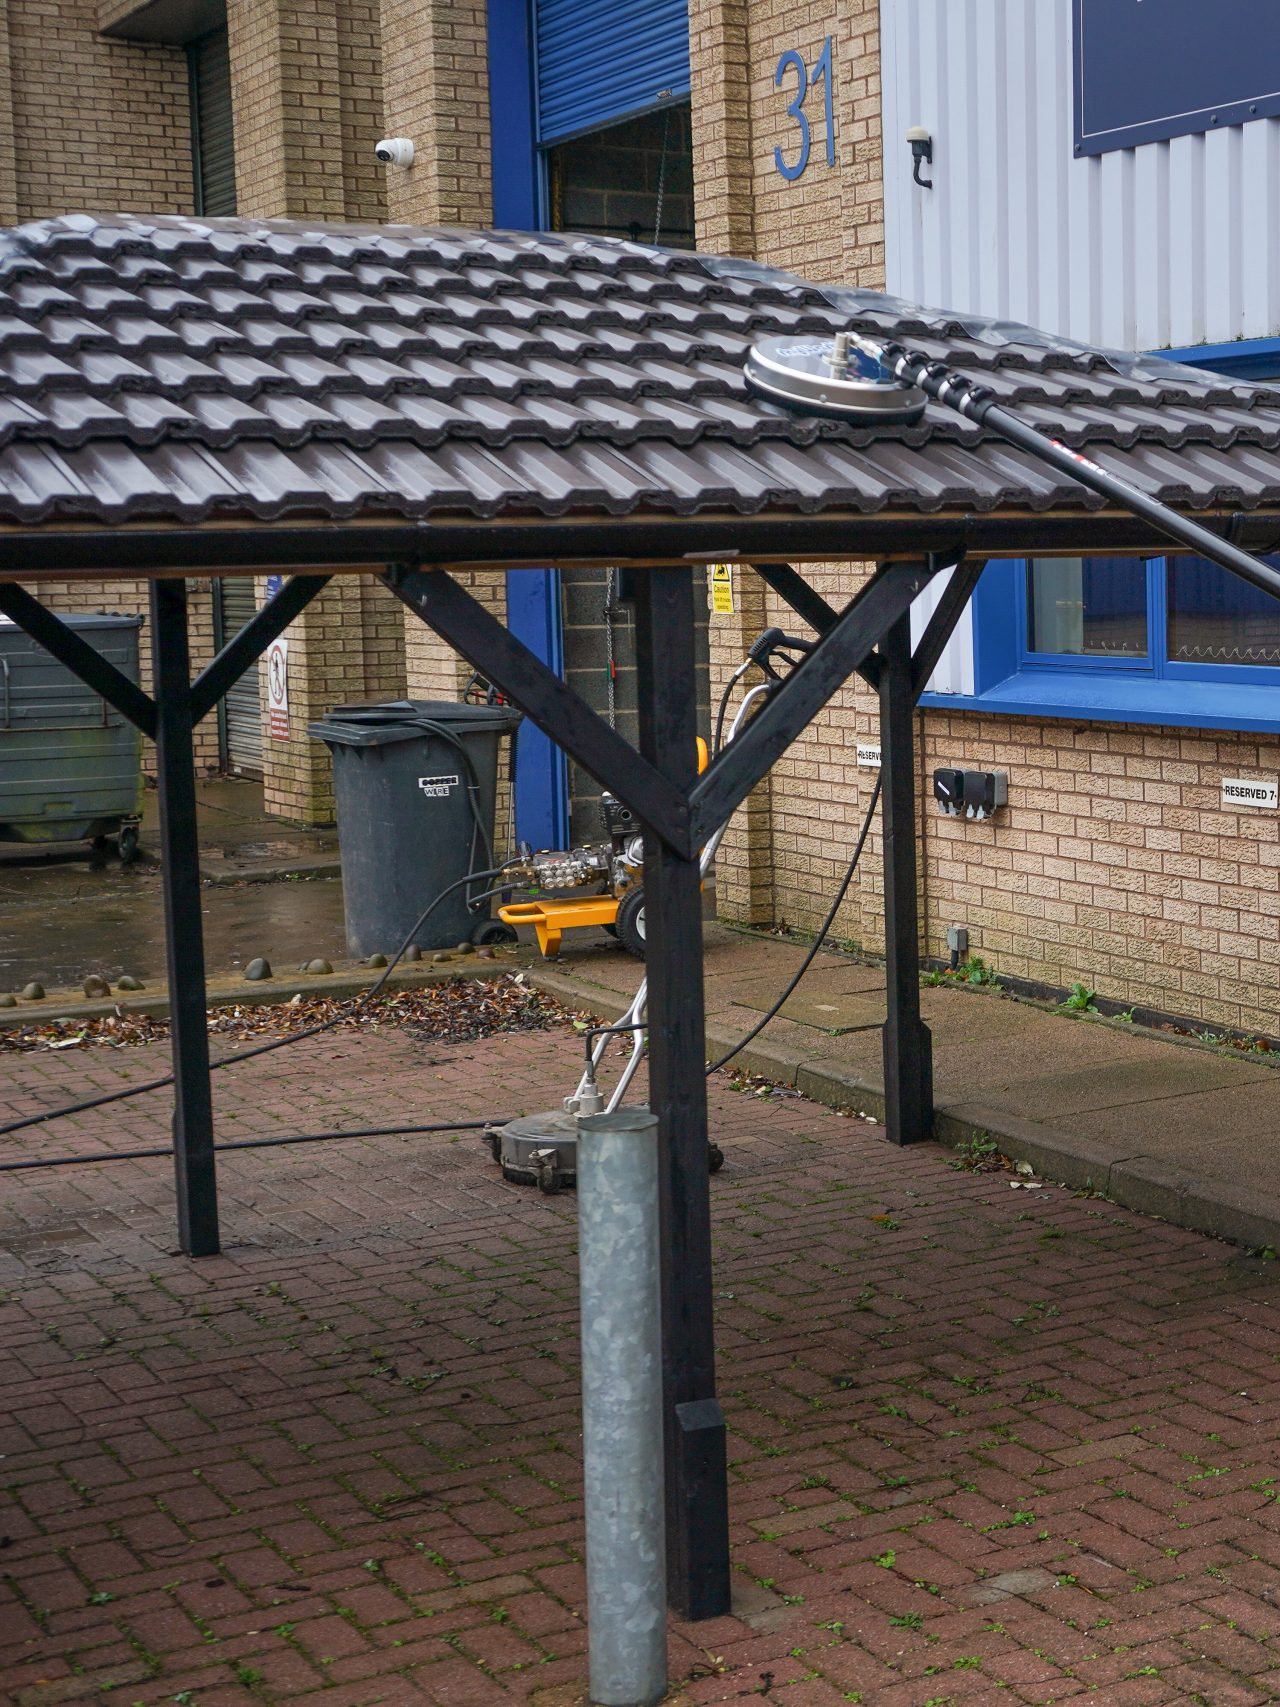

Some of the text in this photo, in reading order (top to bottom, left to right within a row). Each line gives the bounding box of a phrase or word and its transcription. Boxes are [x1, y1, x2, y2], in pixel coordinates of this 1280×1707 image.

[774, 34, 835, 181] 31
[714, 585, 730, 594] Caution
[422, 777, 457, 786] COPPER
[425, 787, 449, 795] WIRE
[1225, 785, 1275, 801] RESERVED 7
